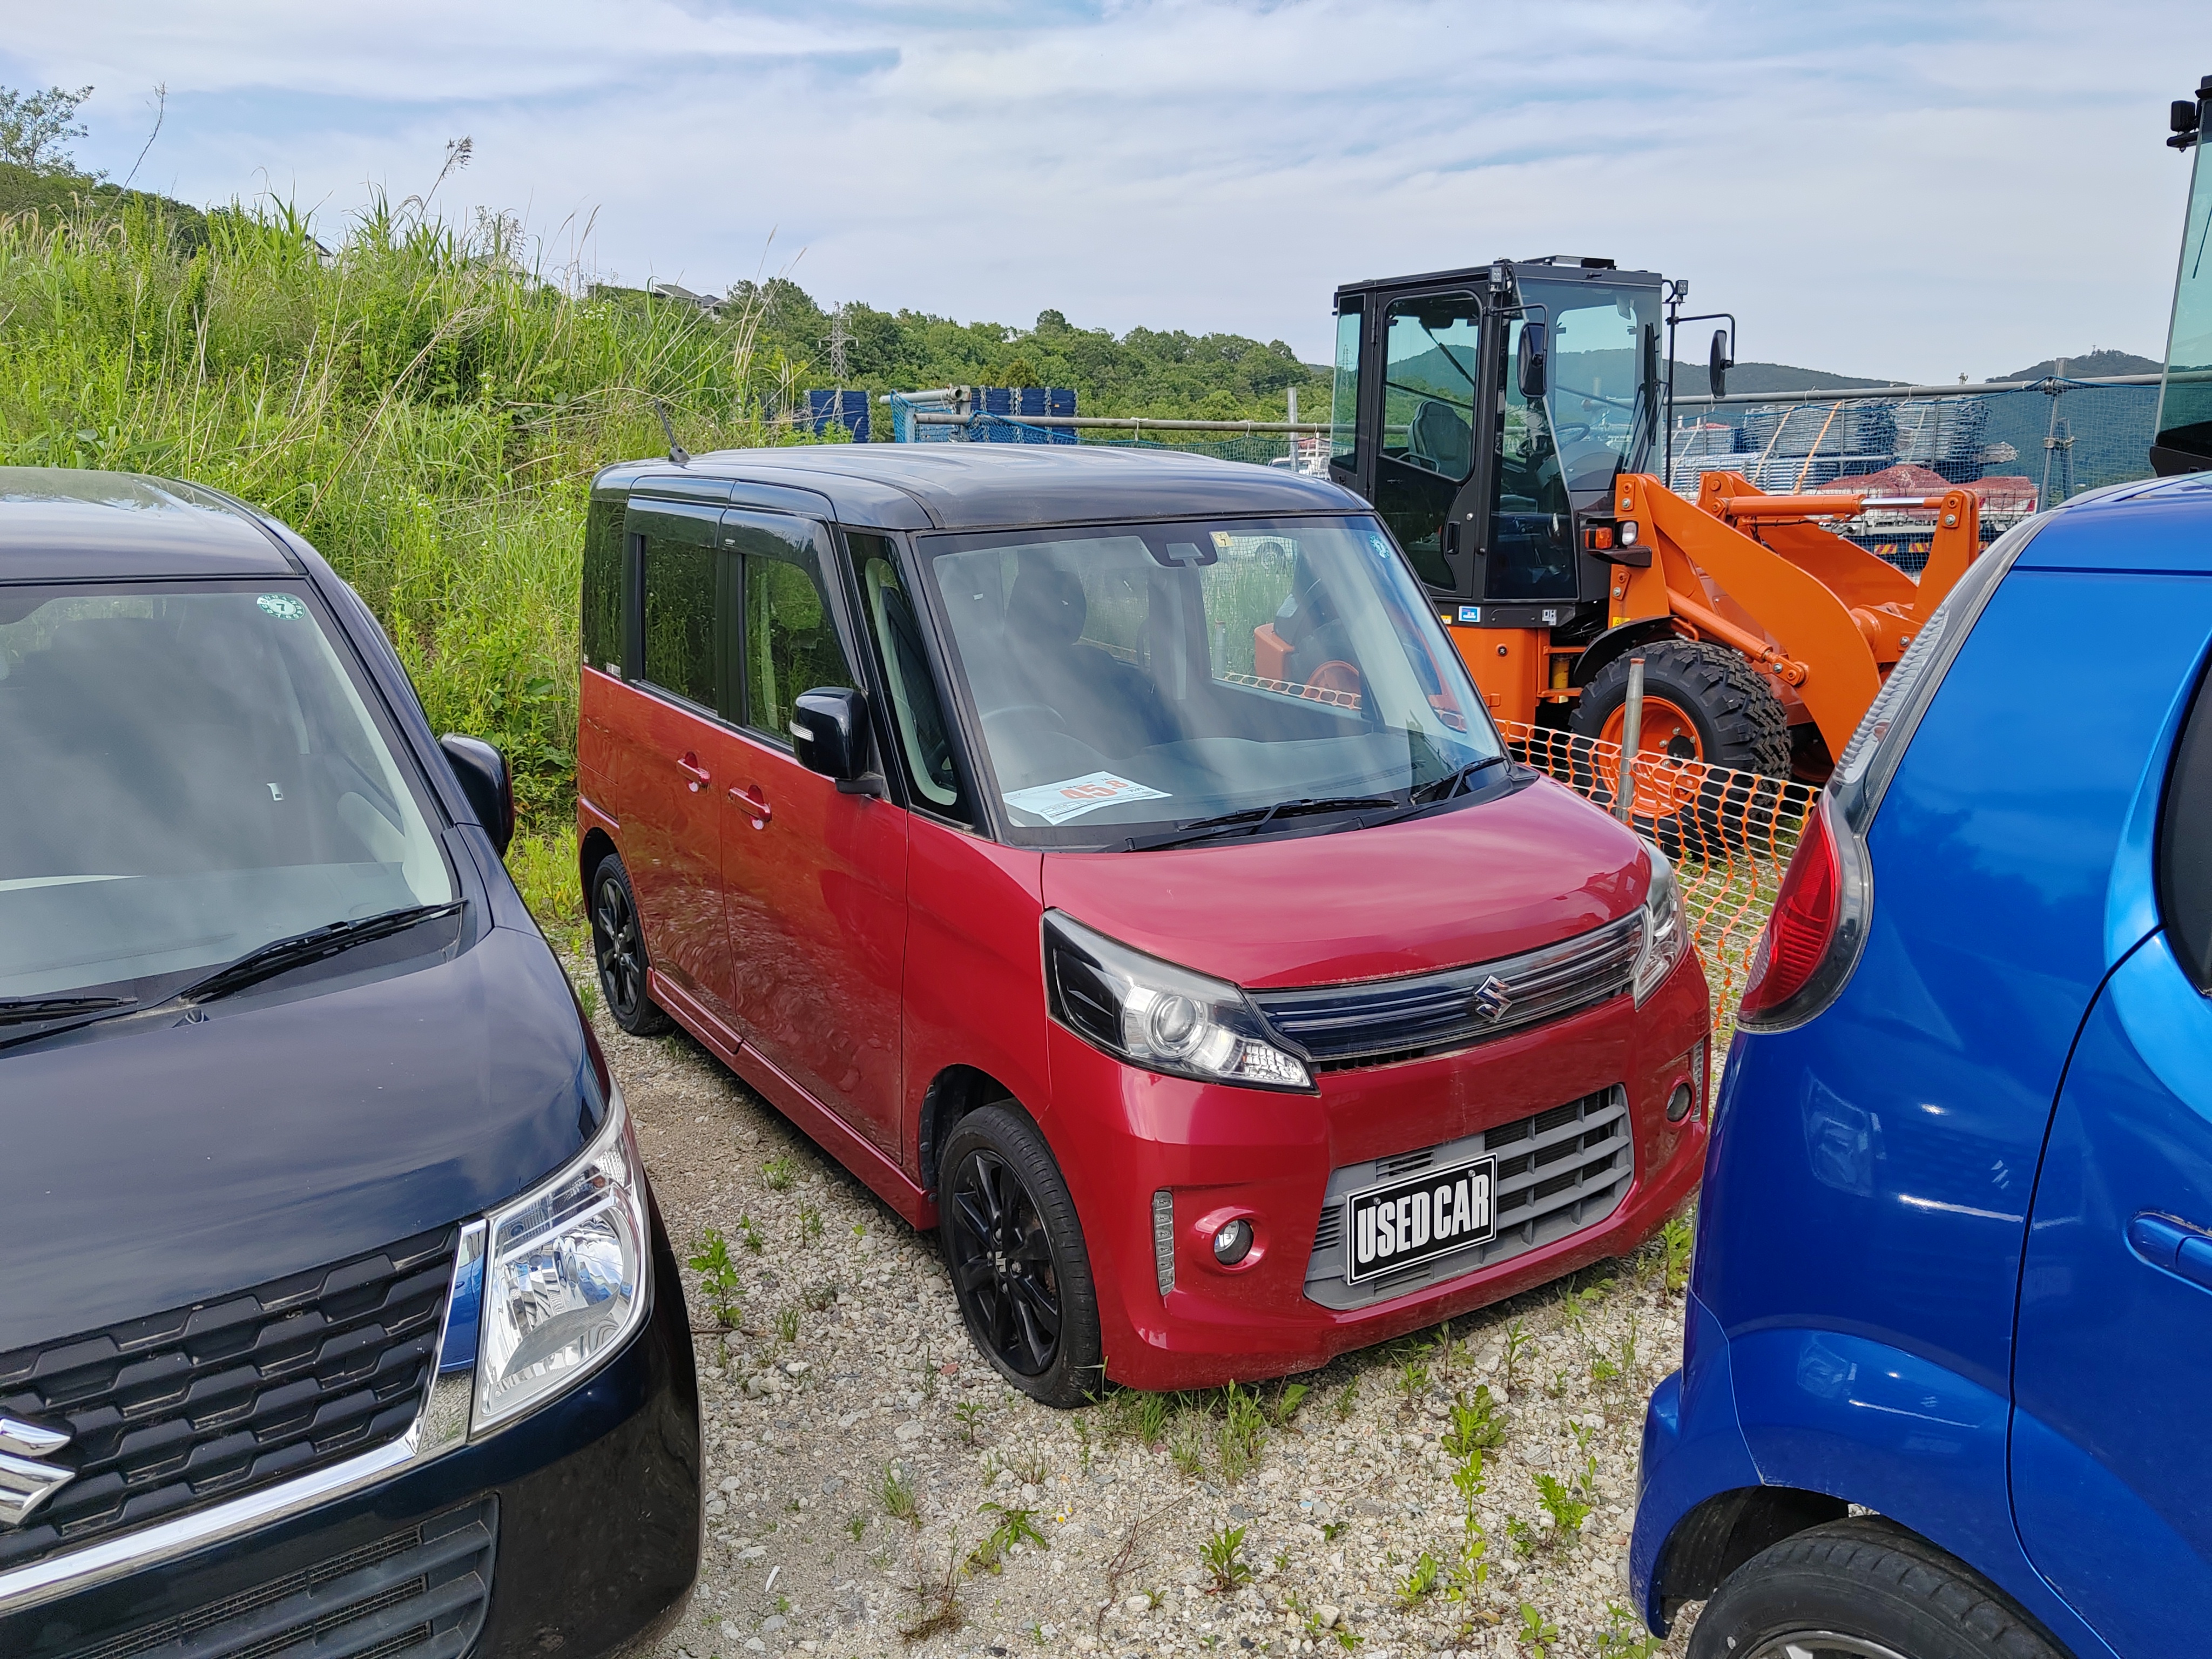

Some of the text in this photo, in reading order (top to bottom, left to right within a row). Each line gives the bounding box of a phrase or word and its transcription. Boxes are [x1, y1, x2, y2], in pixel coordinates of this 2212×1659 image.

[276, 603, 285, 611] 7
[1358, 1174, 1489, 1264] USED CAR
